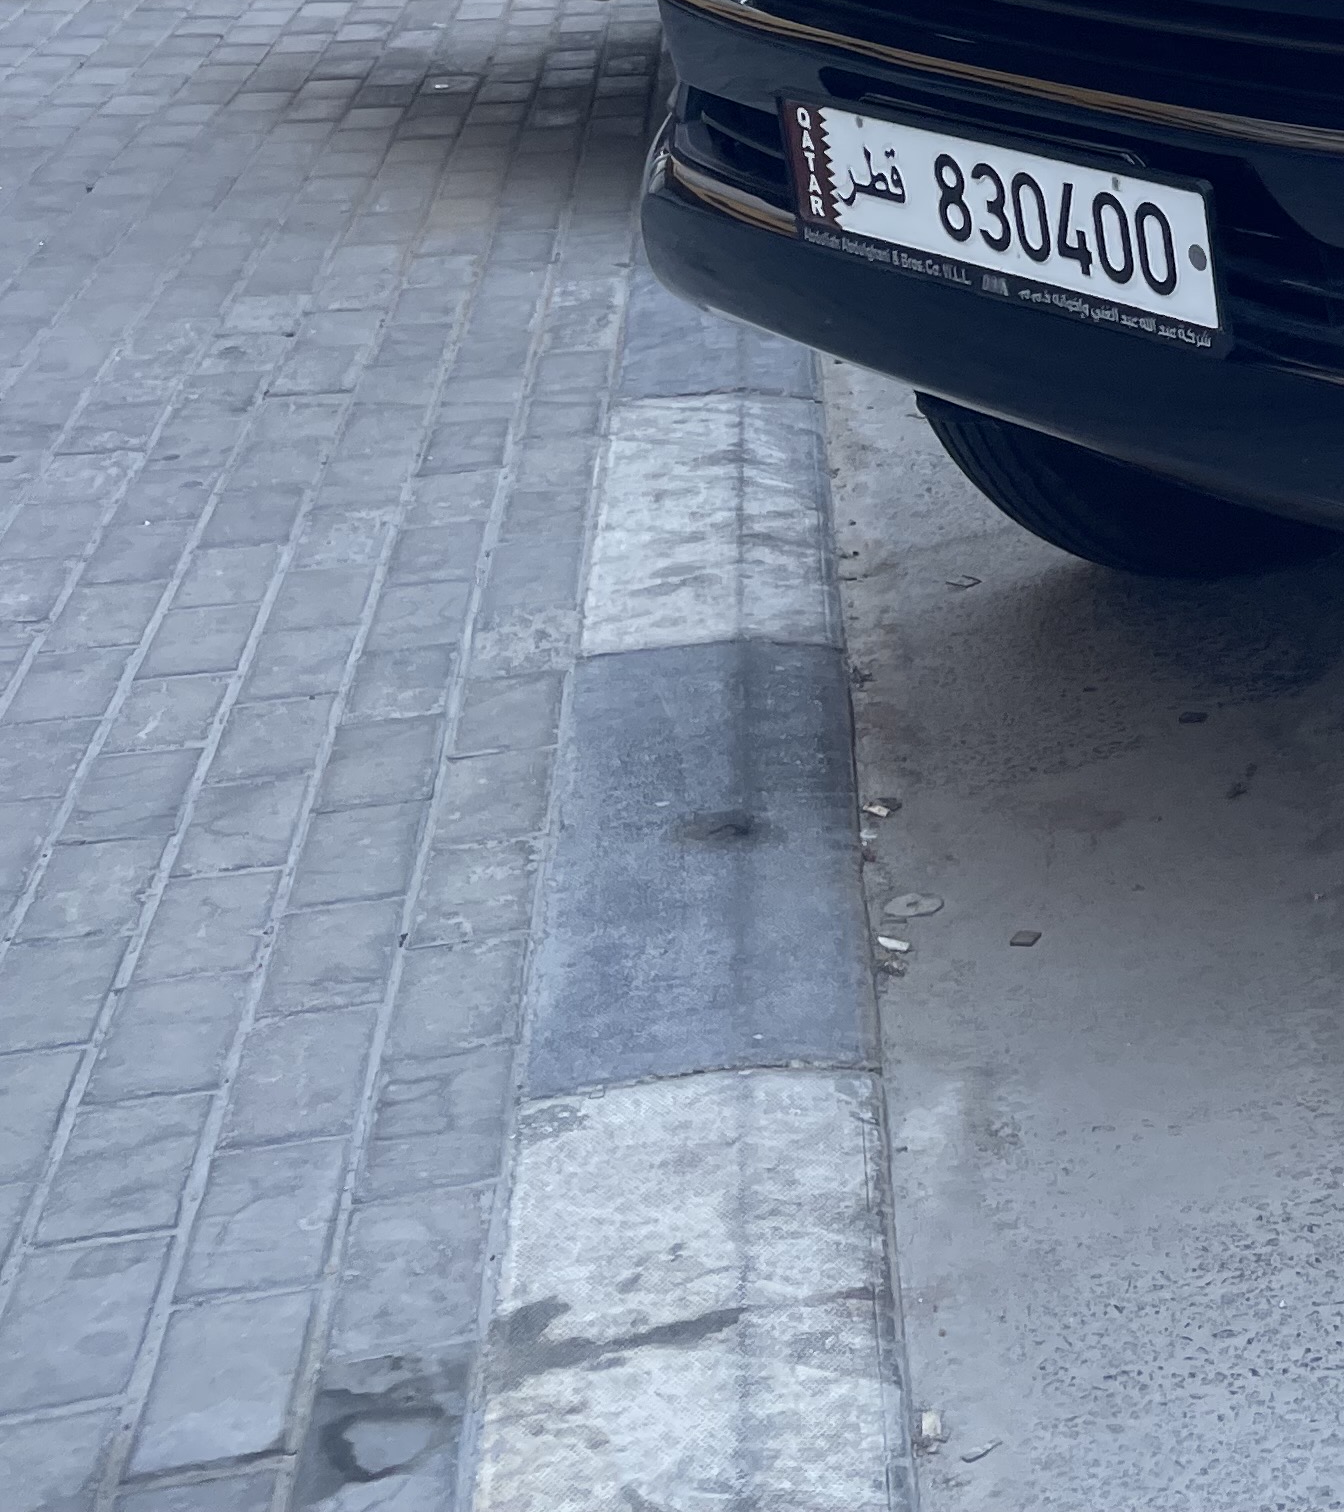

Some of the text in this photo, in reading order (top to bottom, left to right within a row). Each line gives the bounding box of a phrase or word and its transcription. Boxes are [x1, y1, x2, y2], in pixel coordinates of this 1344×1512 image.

[795, 106, 826, 218] QATAR
[841, 144, 907, 207] قطر
[933, 152, 1179, 297] 830400
